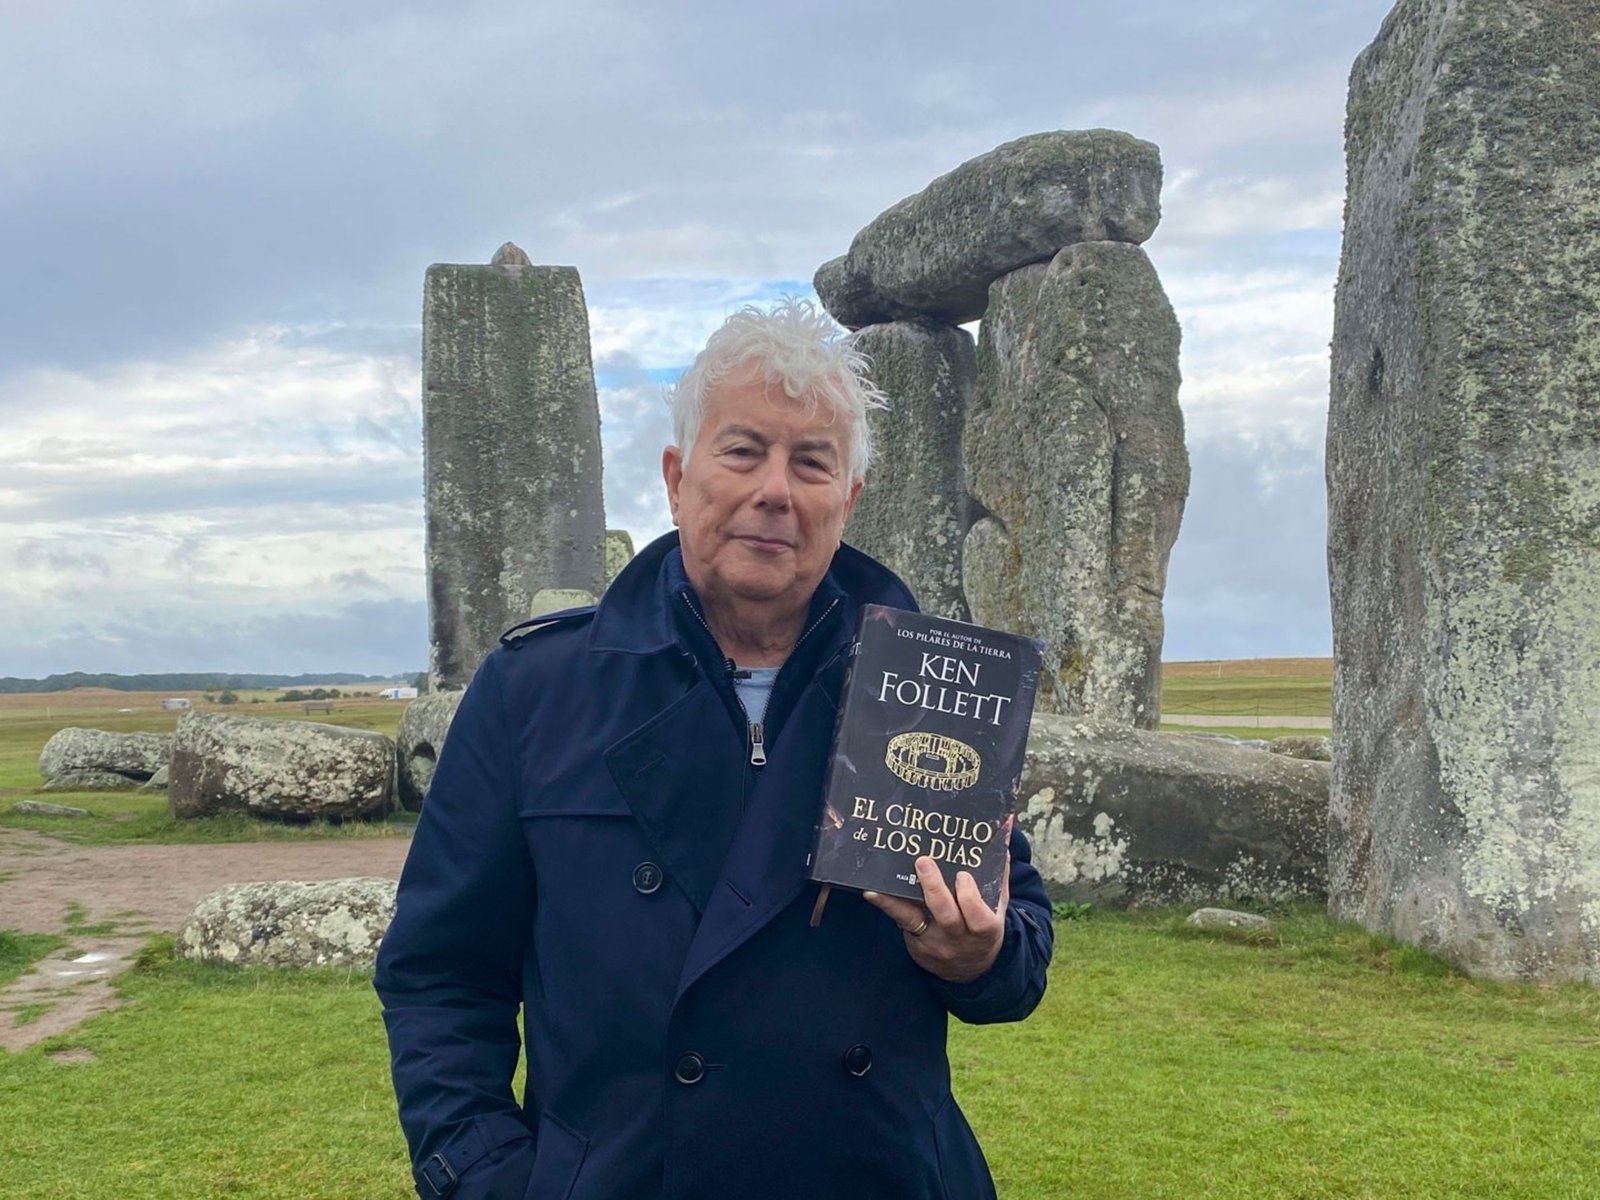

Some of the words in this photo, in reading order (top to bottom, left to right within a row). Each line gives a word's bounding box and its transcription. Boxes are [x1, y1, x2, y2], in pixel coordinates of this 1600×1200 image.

[897, 628, 914, 639] LOS
[916, 632, 951, 647] PILARES
[952, 639, 966, 650] DE
[966, 643, 978, 653] LA
[980, 645, 1012, 659] TIERRA
[929, 629, 943, 637] POR
[943, 630, 951, 638] EL
[951, 633, 972, 642] AUTOR
[973, 637, 982, 645] DE
[918, 652, 982, 687] KEN
[877, 671, 1012, 726] FOLLETT
[852, 796, 879, 822] EL
[885, 803, 993, 843] CÍRCULO
[853, 827, 869, 842] de
[873, 827, 922, 857] LOS
[928, 836, 983, 868] DÍAS
